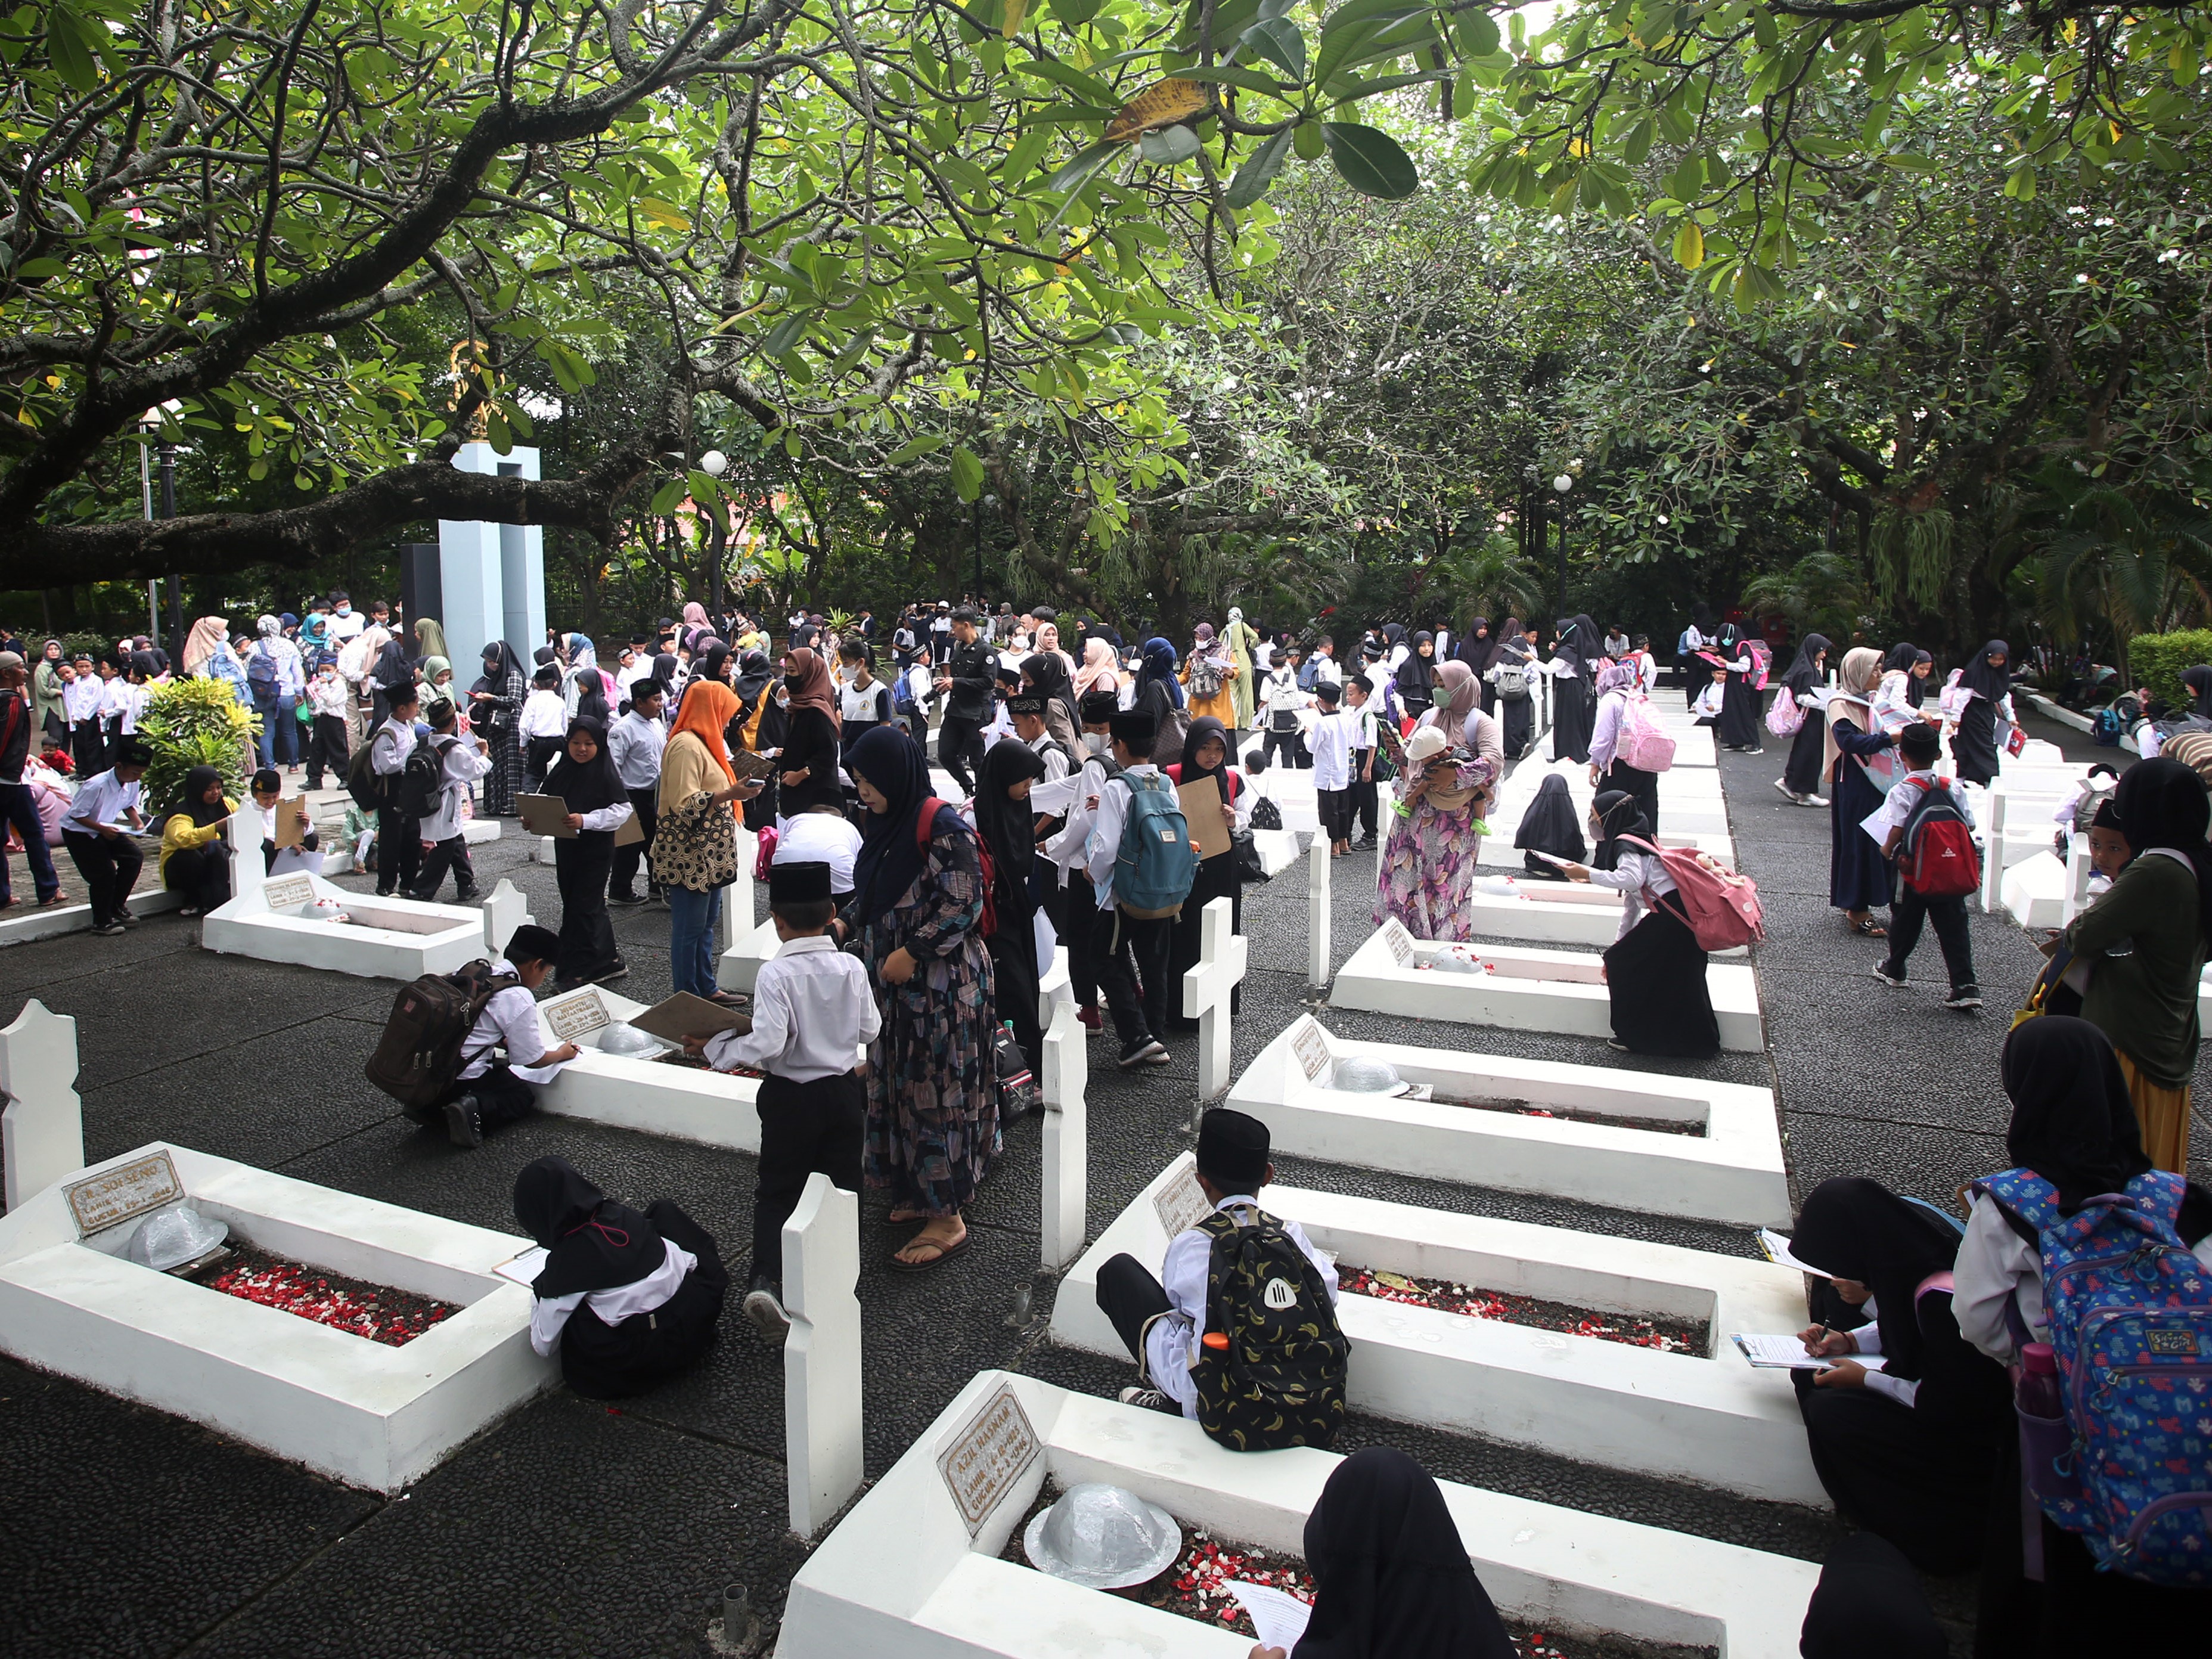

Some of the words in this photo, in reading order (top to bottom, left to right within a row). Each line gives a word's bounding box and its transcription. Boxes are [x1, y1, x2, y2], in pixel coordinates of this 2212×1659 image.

[2154, 1334, 2183, 1344] Silver
[956, 1445, 977, 1475] AZIL
[977, 1406, 1010, 1449] HASNAM
[965, 1469, 986, 1497] LAHIR
